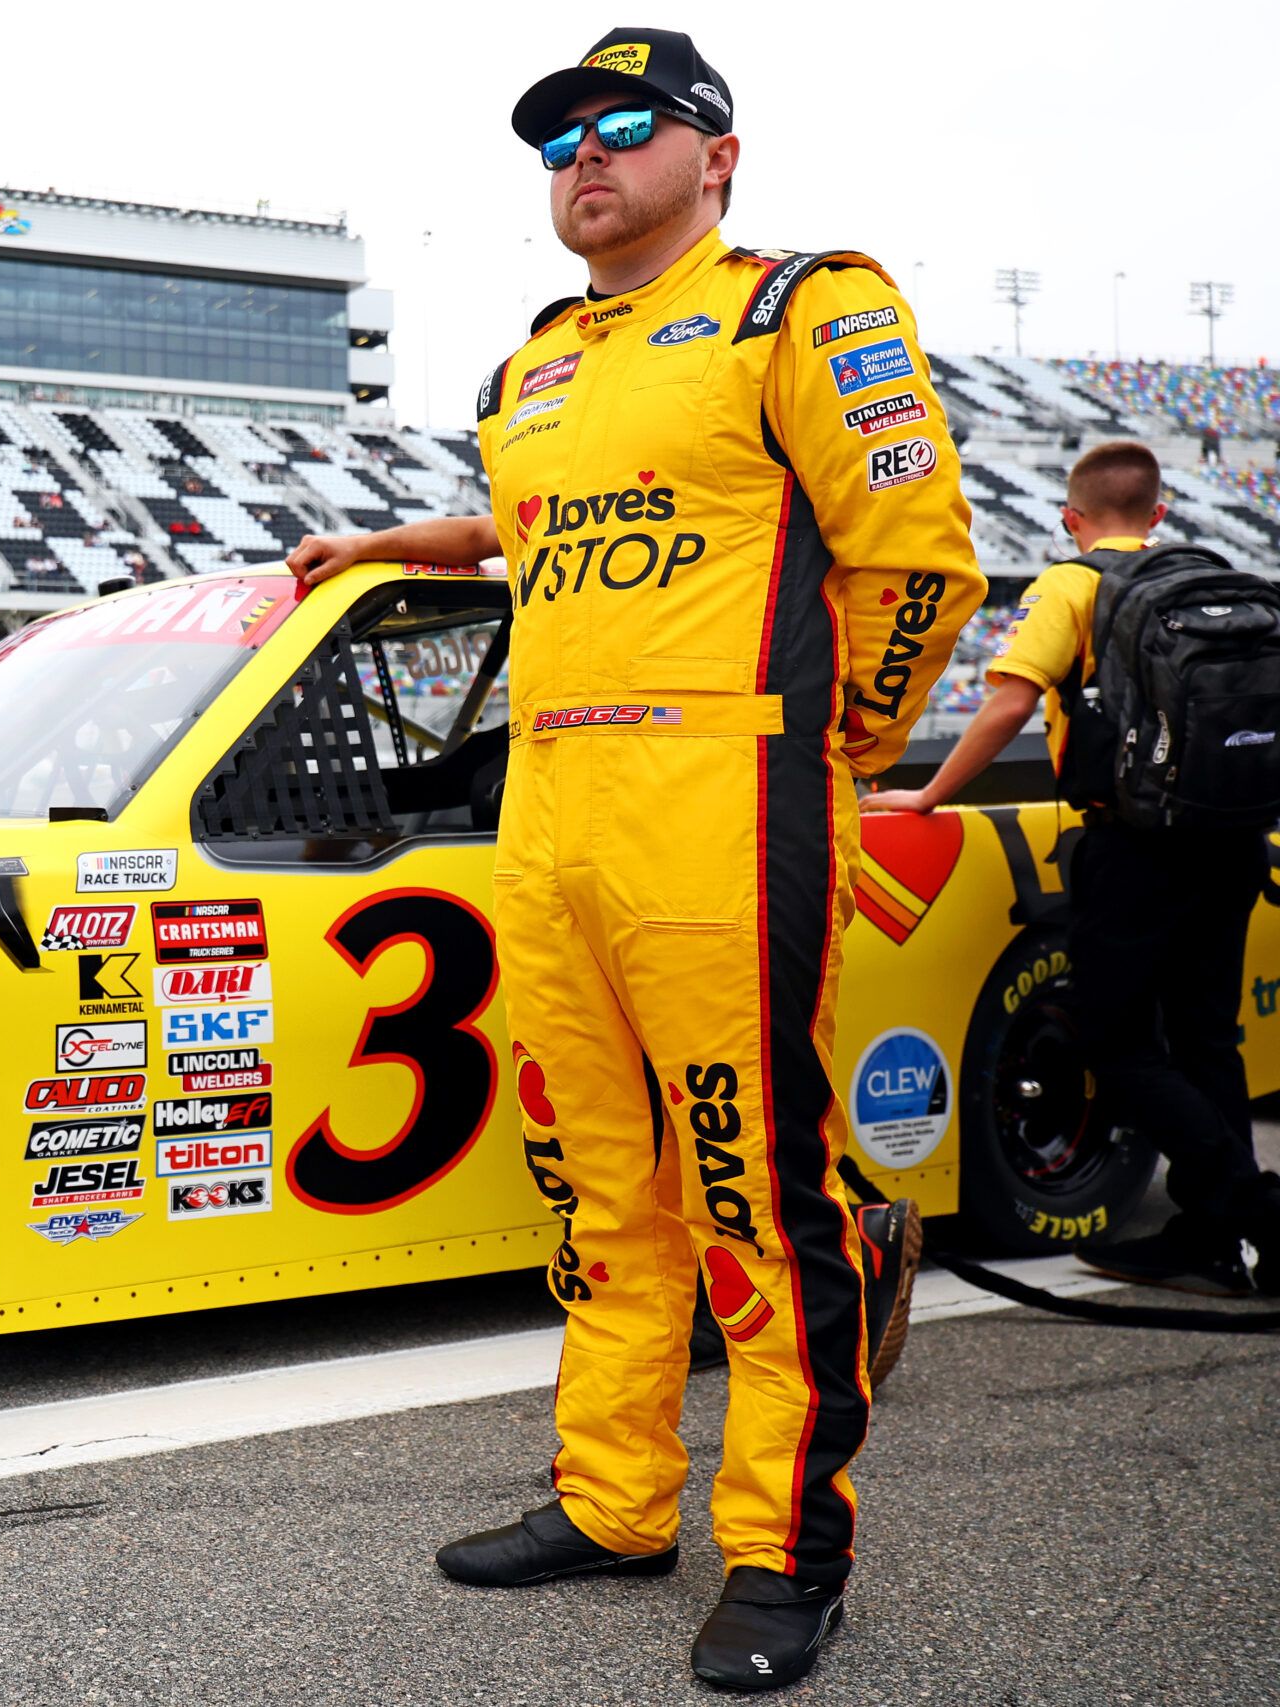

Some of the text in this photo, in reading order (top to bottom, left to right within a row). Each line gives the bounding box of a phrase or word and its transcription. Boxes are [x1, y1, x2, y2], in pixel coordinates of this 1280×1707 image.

[752, 255, 815, 326] sparco
[660, 318, 709, 341] Ford
[838, 307, 898, 337] NASCAR
[860, 346, 904, 366] SHERWIN
[523, 362, 577, 391] CRAFTSMAN
[850, 396, 914, 425] LINCOLN
[869, 408, 922, 432] WELDERS
[871, 470, 925, 490] RACING ELECTRONICS
[533, 704, 650, 731] RIGGS
[109, 855, 163, 870] NASCAR
[84, 872, 168, 885] RACE TRUCK
[195, 904, 230, 916] NASCAR
[54, 911, 129, 938] KLOTZ
[159, 921, 260, 941] CRAFTSMAN
[85, 938, 122, 946] SYNTHETICS
[188, 946, 235, 958] TRUCK SERIES
[169, 963, 263, 996] DART
[79, 1002, 144, 1016] KENNAMETAL
[167, 1009, 269, 1044] SKF
[172, 1051, 255, 1074] LINCOLN
[25, 1074, 146, 1110] CALICO
[191, 1072, 263, 1090] WELDERS
[867, 1064, 936, 1098] CLEW
[87, 1103, 144, 1113] COATINGS
[155, 1099, 229, 1131] Holley
[30, 1123, 141, 1153] COMETIC
[37, 1149, 80, 1158] GASKET
[165, 1142, 264, 1170] tilton
[34, 1160, 145, 1196] JESEL
[42, 1190, 134, 1205] SHAFT ROCKER ARMS
[171, 1178, 266, 1214] KOOKS
[48, 1211, 121, 1229] FIVE STAR
[1028, 1204, 1108, 1240] EAGLE
